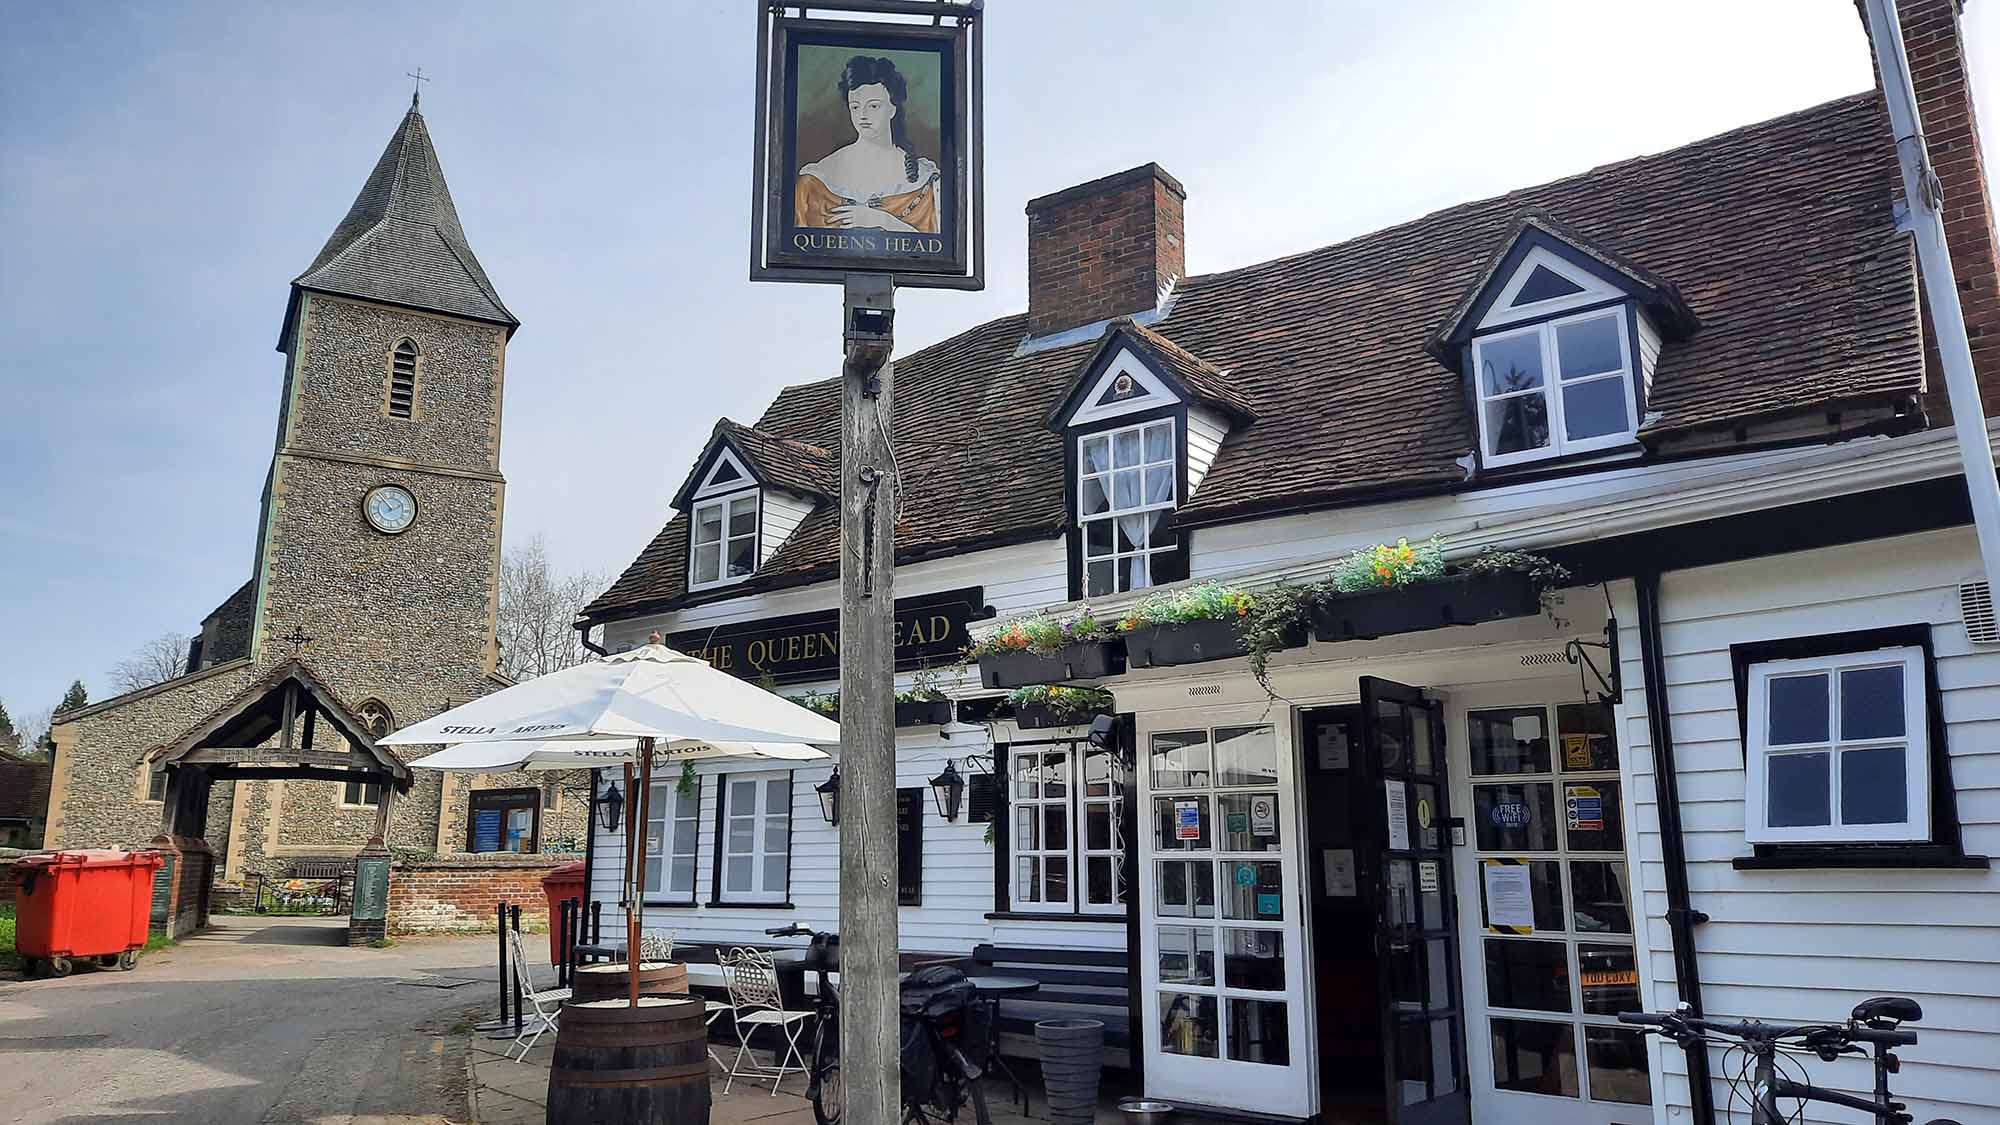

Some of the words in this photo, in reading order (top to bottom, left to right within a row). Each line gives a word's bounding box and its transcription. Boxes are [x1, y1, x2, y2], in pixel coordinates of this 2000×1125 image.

[793, 233, 876, 253] QUEENS
[885, 237, 943, 254] HEAD
[747, 630, 839, 672] QUEEN
[893, 615, 950, 648] EAD
[439, 725, 497, 735] STELLA
[573, 749, 632, 757] STELLA
[1499, 803, 1521, 814] FREE
